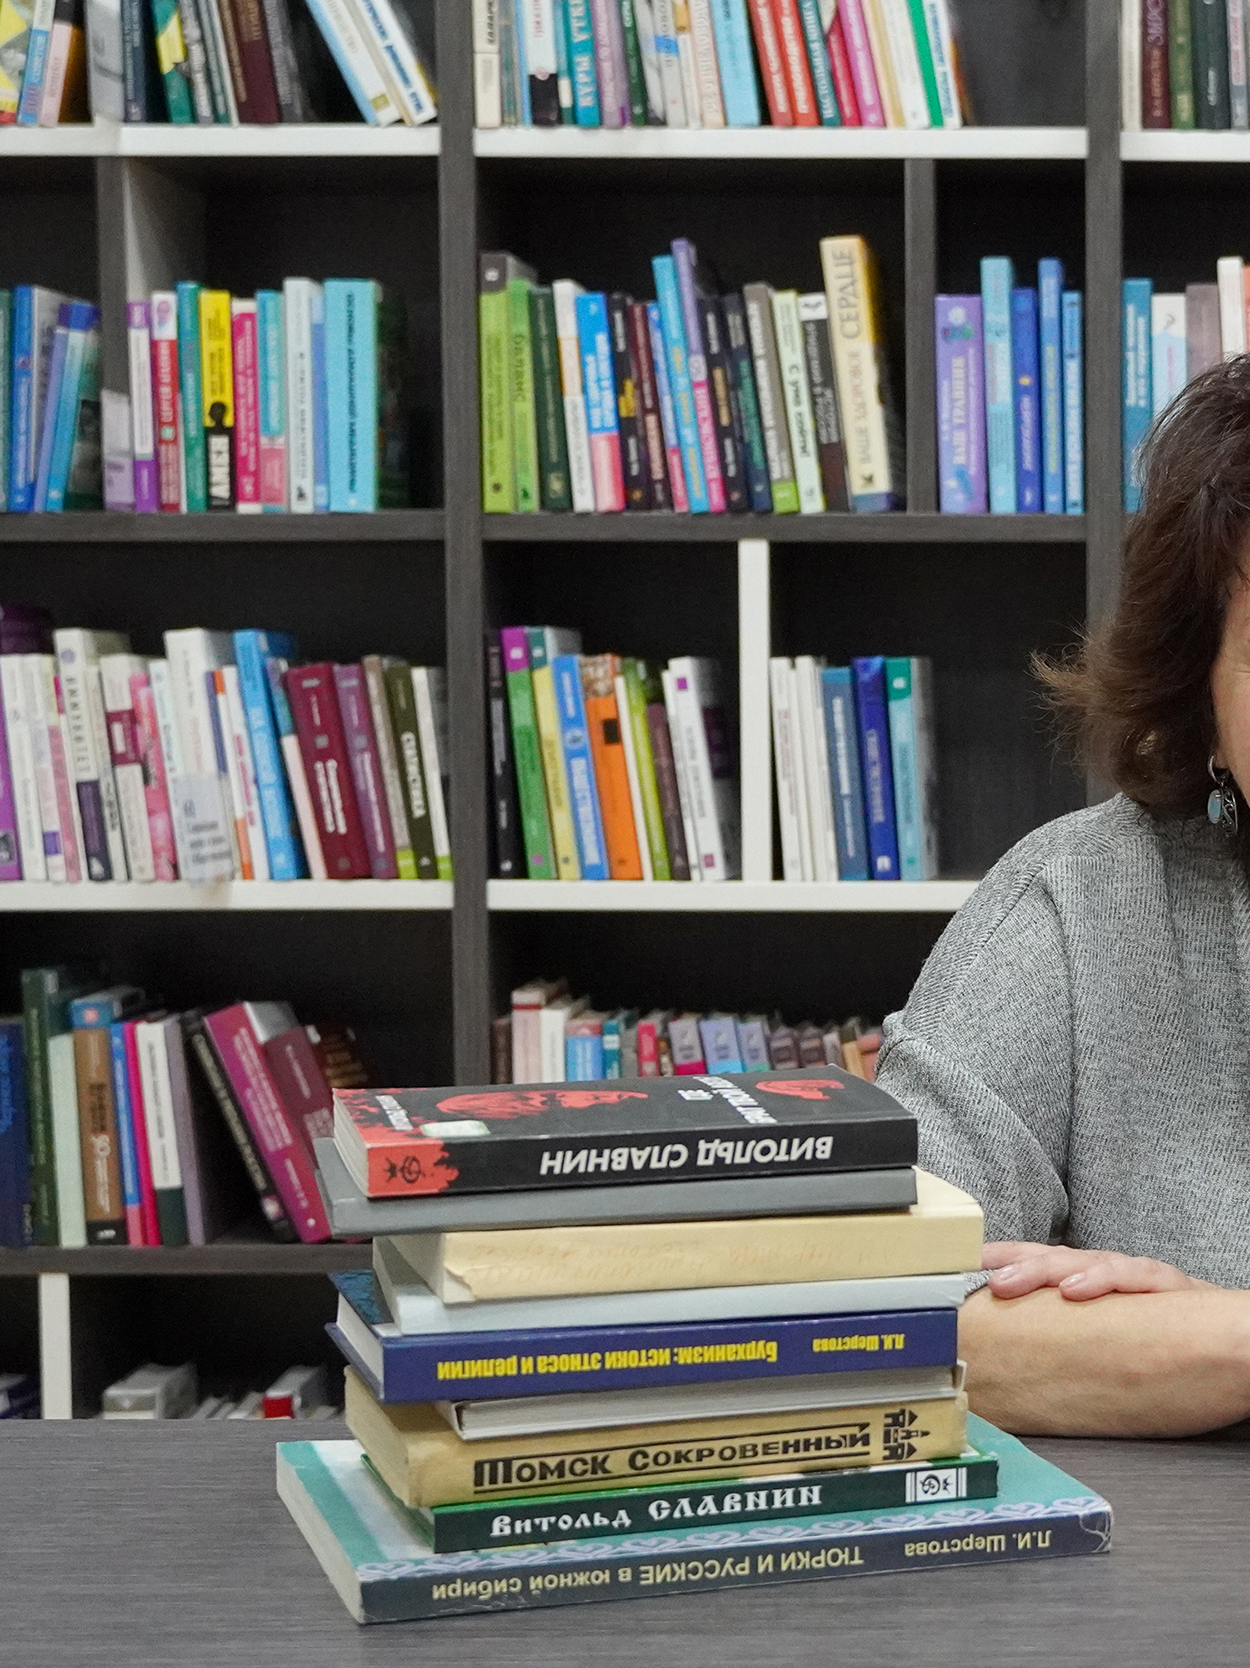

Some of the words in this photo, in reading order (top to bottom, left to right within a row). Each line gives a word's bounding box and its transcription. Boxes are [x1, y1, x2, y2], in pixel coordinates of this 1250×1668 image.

[831, 246, 858, 340] СЕРДЦЕ
[540, 1143, 688, 1176] СЛАВНИН
[698, 1136, 834, 1168] ВИТОЛЬД
[673, 1340, 778, 1364] Бурханизм:
[812, 1336, 879, 1353] Шерстова
[884, 1334, 905, 1349] Л.И.
[437, 1356, 518, 1381] религии
[521, 1357, 534, 1375] и
[537, 1351, 602, 1374] этноса
[605, 1346, 671, 1369] истоки
[648, 1485, 822, 1520] СЛАВНИН
[904, 1534, 1006, 1556] Шерстова
[1012, 1530, 1052, 1549] Л.И.
[640, 1556, 750, 1584] РУССКИЕ
[757, 1553, 774, 1574] И
[781, 1546, 864, 1571] ТЮРКИ
